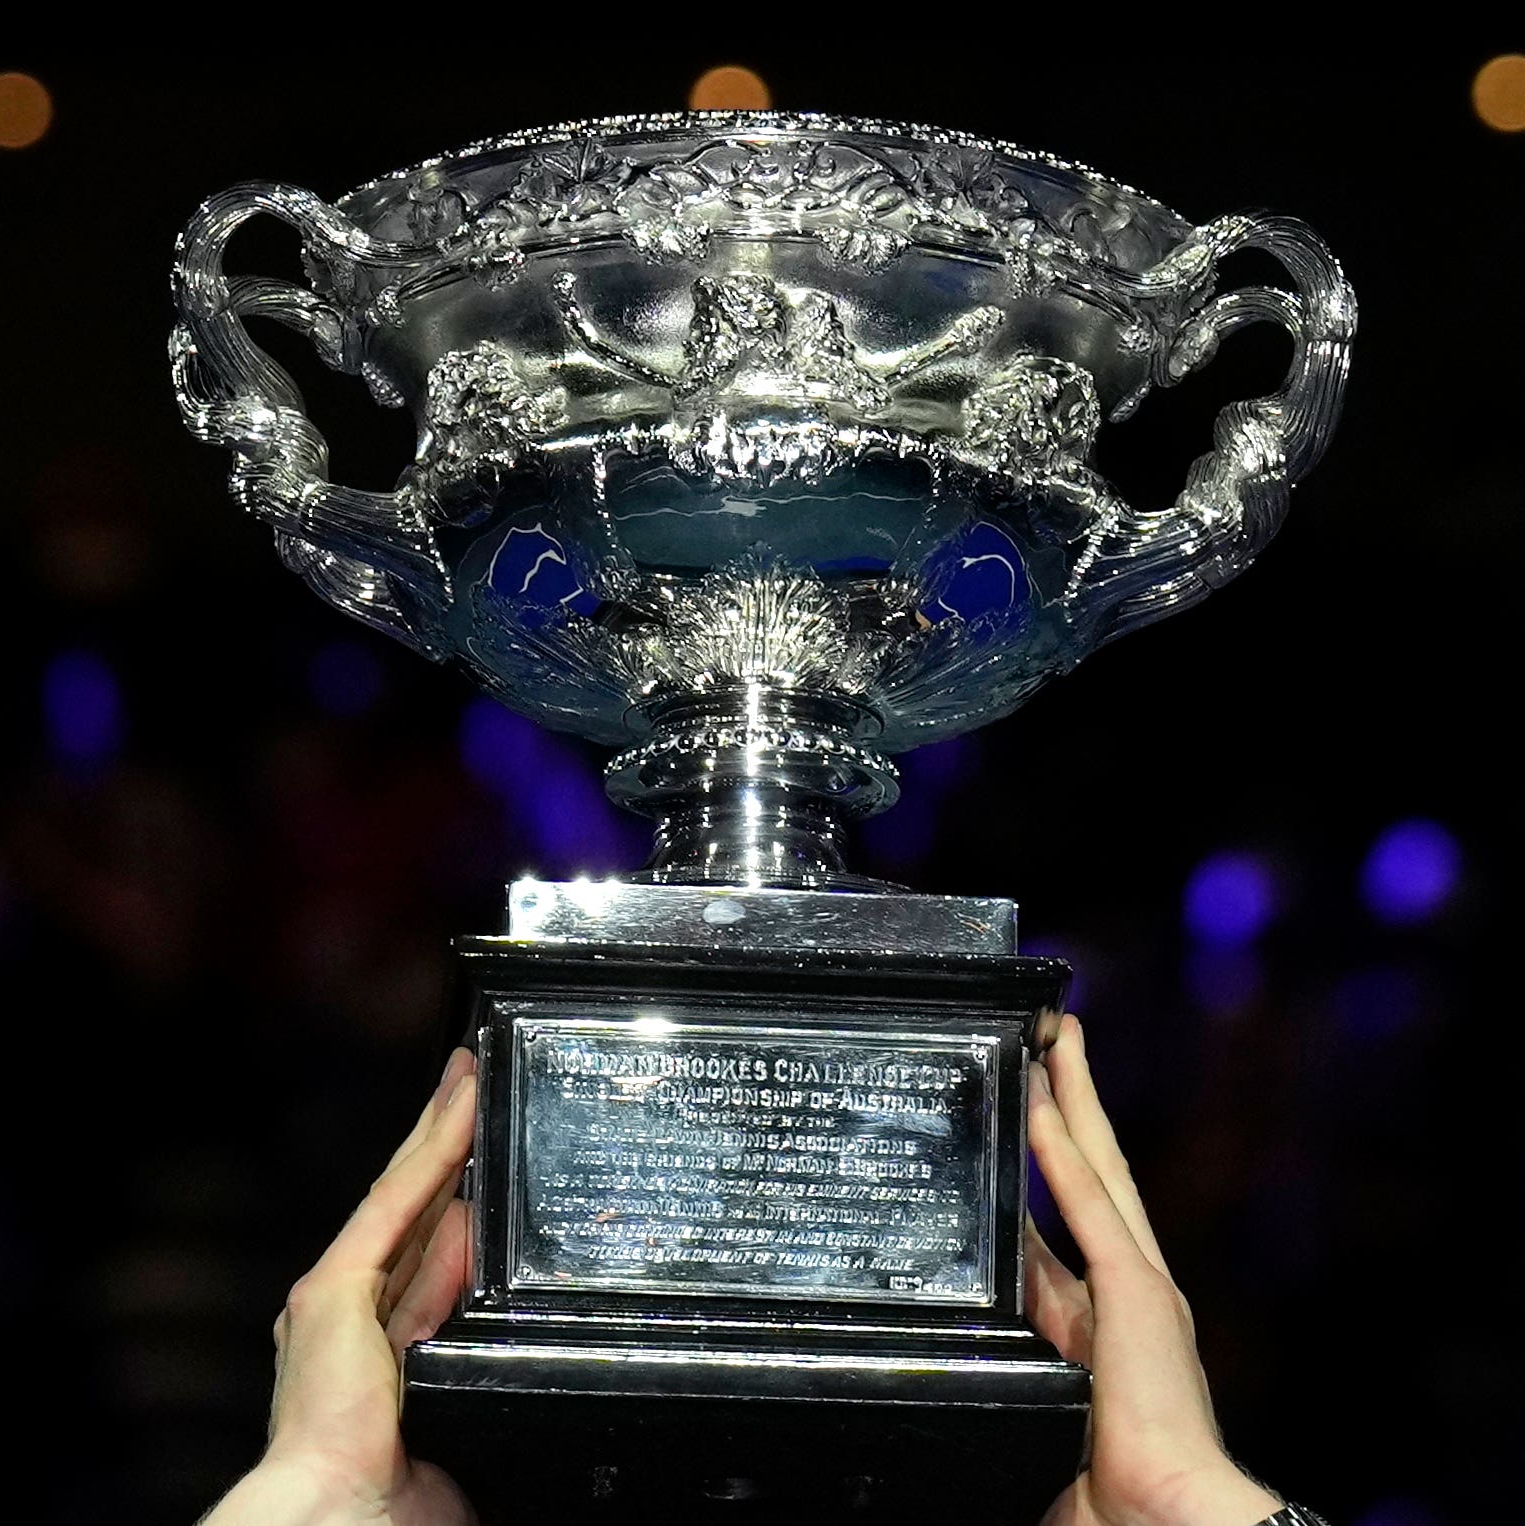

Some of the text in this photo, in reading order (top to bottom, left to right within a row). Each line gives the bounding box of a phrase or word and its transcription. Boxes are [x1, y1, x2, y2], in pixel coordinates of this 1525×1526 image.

[659, 1054, 768, 1083] BROOKES
[774, 1059, 914, 1088] CHALLENGE
[658, 1080, 803, 1108] CHAMPIONSHIP
[780, 1133, 916, 1155] ASSOCIATIONS
